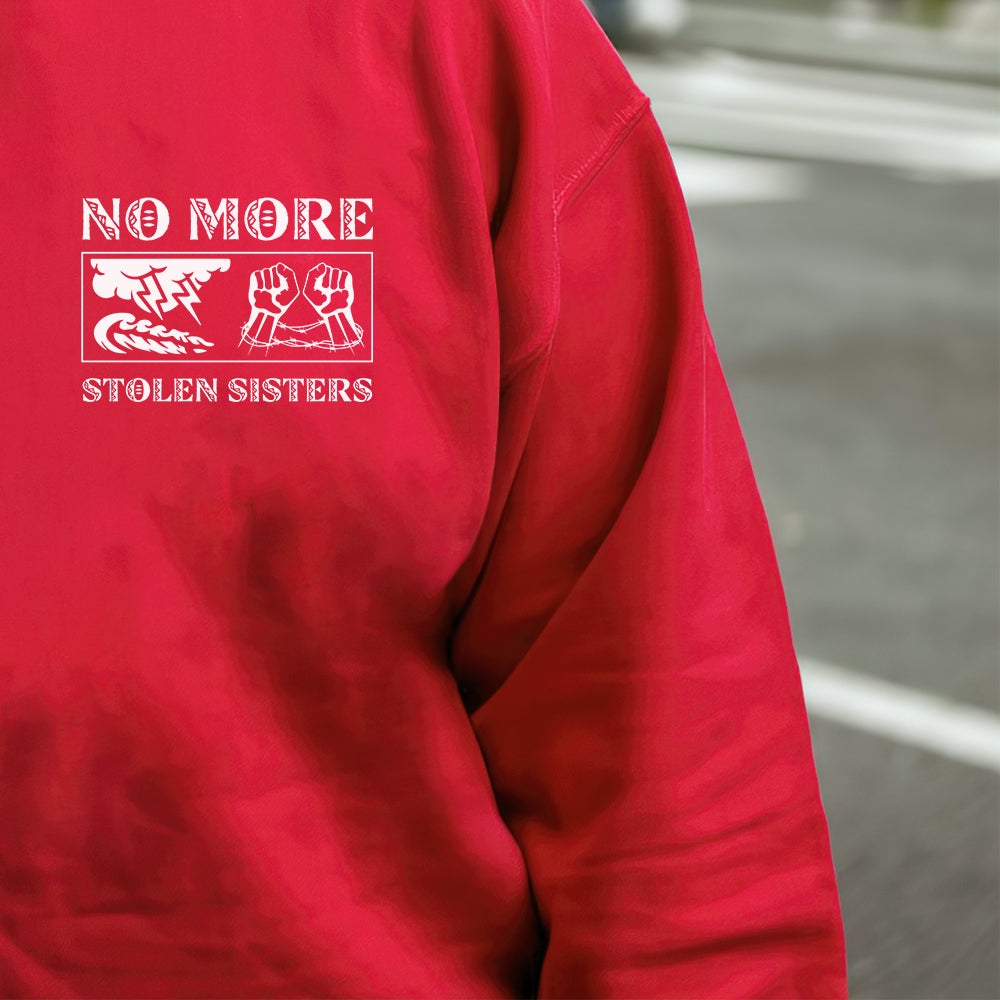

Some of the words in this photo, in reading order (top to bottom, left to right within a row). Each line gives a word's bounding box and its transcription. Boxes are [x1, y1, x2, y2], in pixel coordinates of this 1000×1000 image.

[82, 198, 170, 241] NO
[189, 198, 374, 241] MORE
[82, 377, 218, 403] STOLEN
[228, 377, 373, 403] SISTERS
